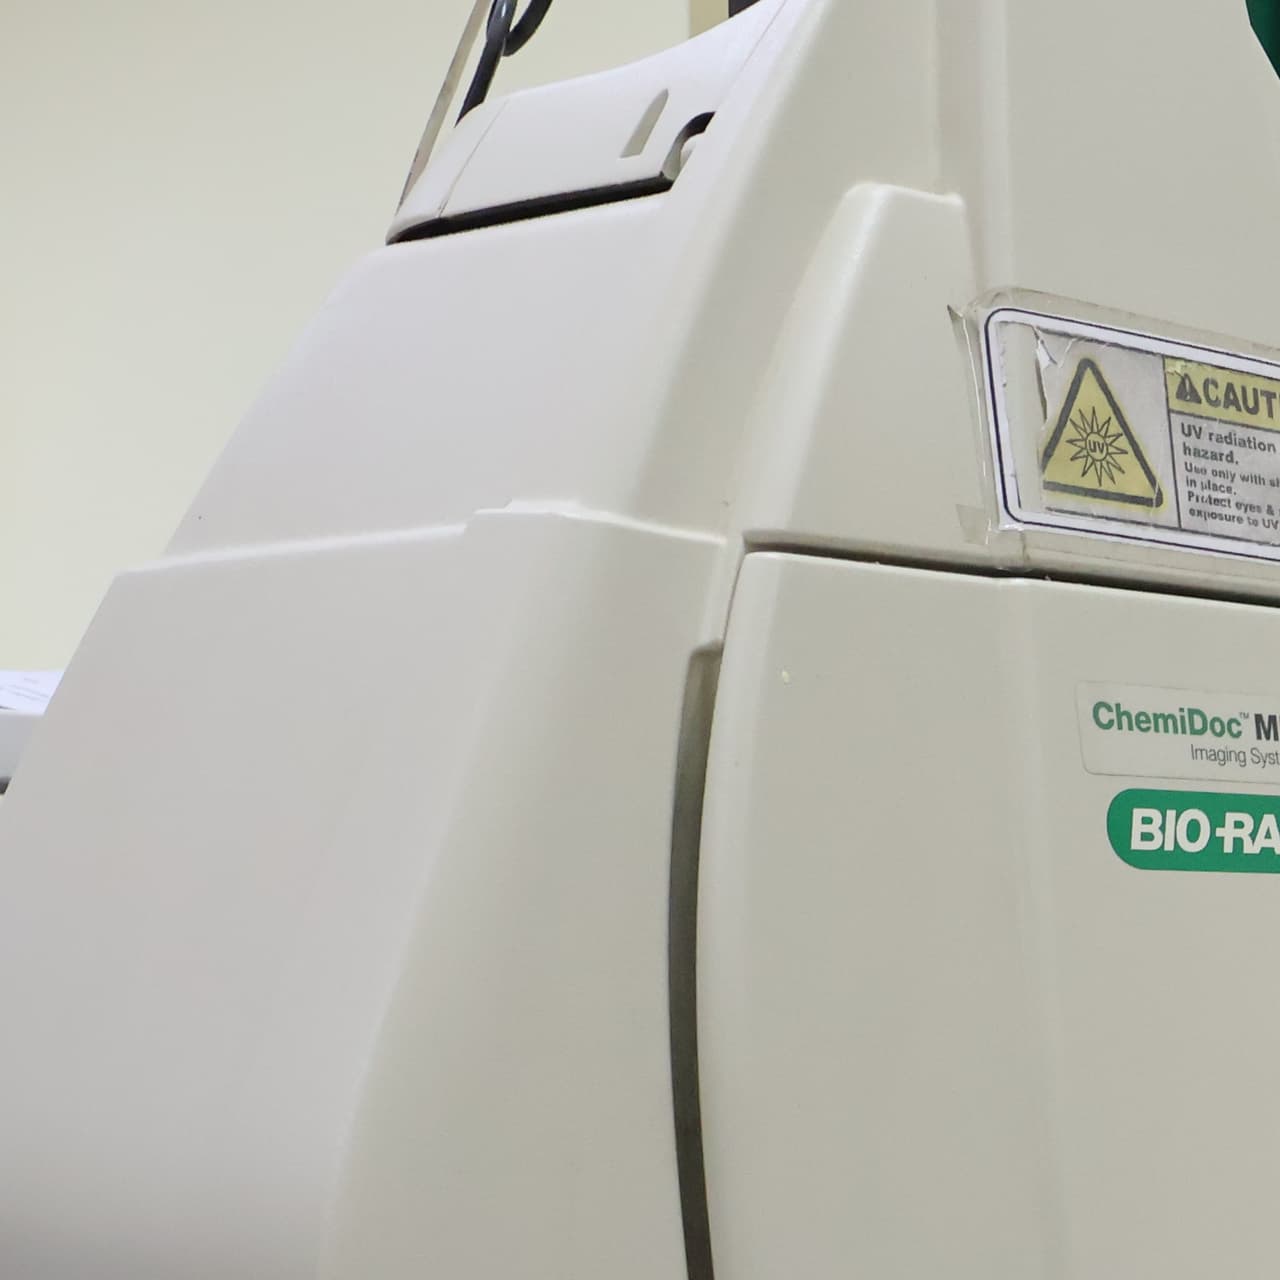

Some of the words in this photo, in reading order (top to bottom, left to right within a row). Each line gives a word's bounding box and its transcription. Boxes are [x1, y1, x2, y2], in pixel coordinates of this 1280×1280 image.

[1181, 422, 1202, 440] UV
[1208, 431, 1277, 454] radiation
[1183, 442, 1239, 465] hazard.
[1186, 476, 1197, 489] in
[1212, 466, 1236, 483] only
[1239, 472, 1266, 486] with
[1187, 490, 1232, 509] Protect
[1235, 500, 1263, 514] eyes
[1266, 504, 1275, 516] &
[1262, 518, 1279, 531] UV
[1190, 743, 1247, 768] Imaging
